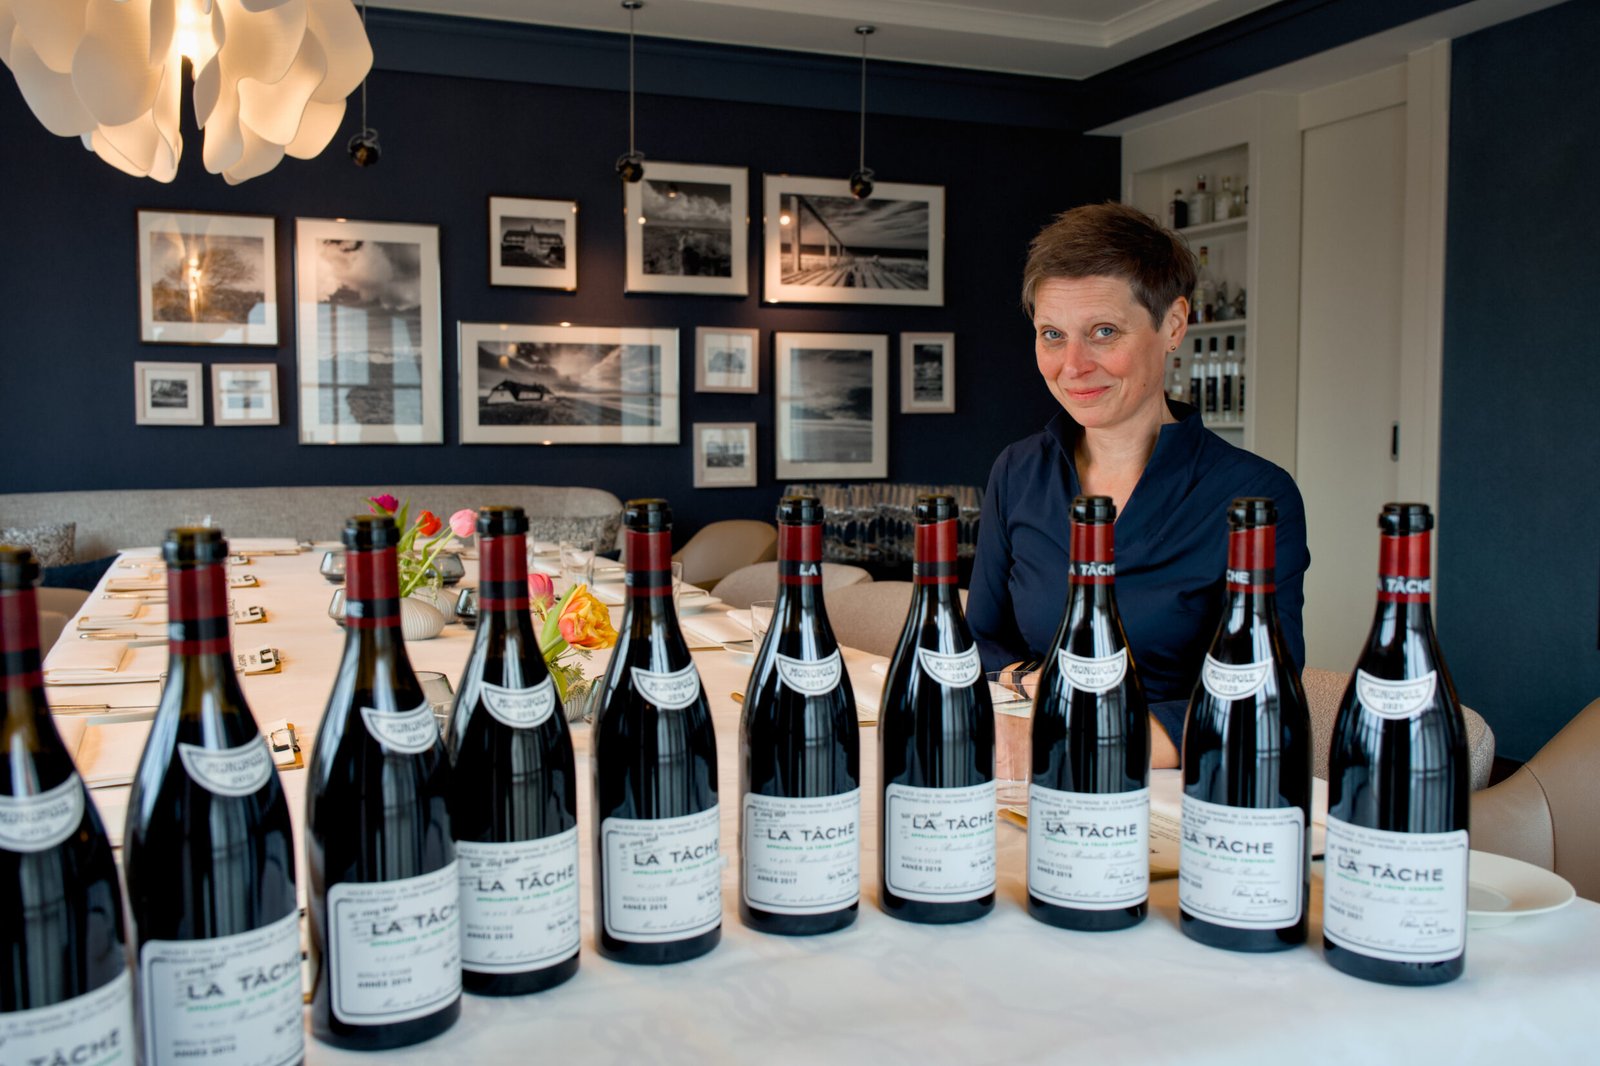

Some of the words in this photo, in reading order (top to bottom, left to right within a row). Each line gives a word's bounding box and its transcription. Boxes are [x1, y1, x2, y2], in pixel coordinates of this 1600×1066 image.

[799, 563, 818, 576] LA
[1080, 561, 1116, 576] TÂCH
[1226, 569, 1250, 585] CHE
[1386, 575, 1431, 594] TÂCH
[1070, 663, 1118, 675] MONOPOLE
[913, 815, 936, 830] LA
[946, 811, 993, 830] TÂCHE
[1046, 821, 1067, 835] LA
[1076, 823, 1137, 838] TÂCHE
[768, 829, 791, 841] LA
[801, 822, 854, 842] TÂCHE
[1206, 835, 1274, 854] TÂCHE
[634, 854, 659, 866] LA
[1338, 856, 1359, 873] LA
[1368, 864, 1443, 882] TÂCHE
[477, 879, 505, 892] LA
[516, 863, 574, 890] TÂCHE
[371, 919, 402, 936] LA
[414, 902, 458, 929] TÂCH
[187, 983, 223, 1000] LA
[238, 953, 300, 991] TÂCH
